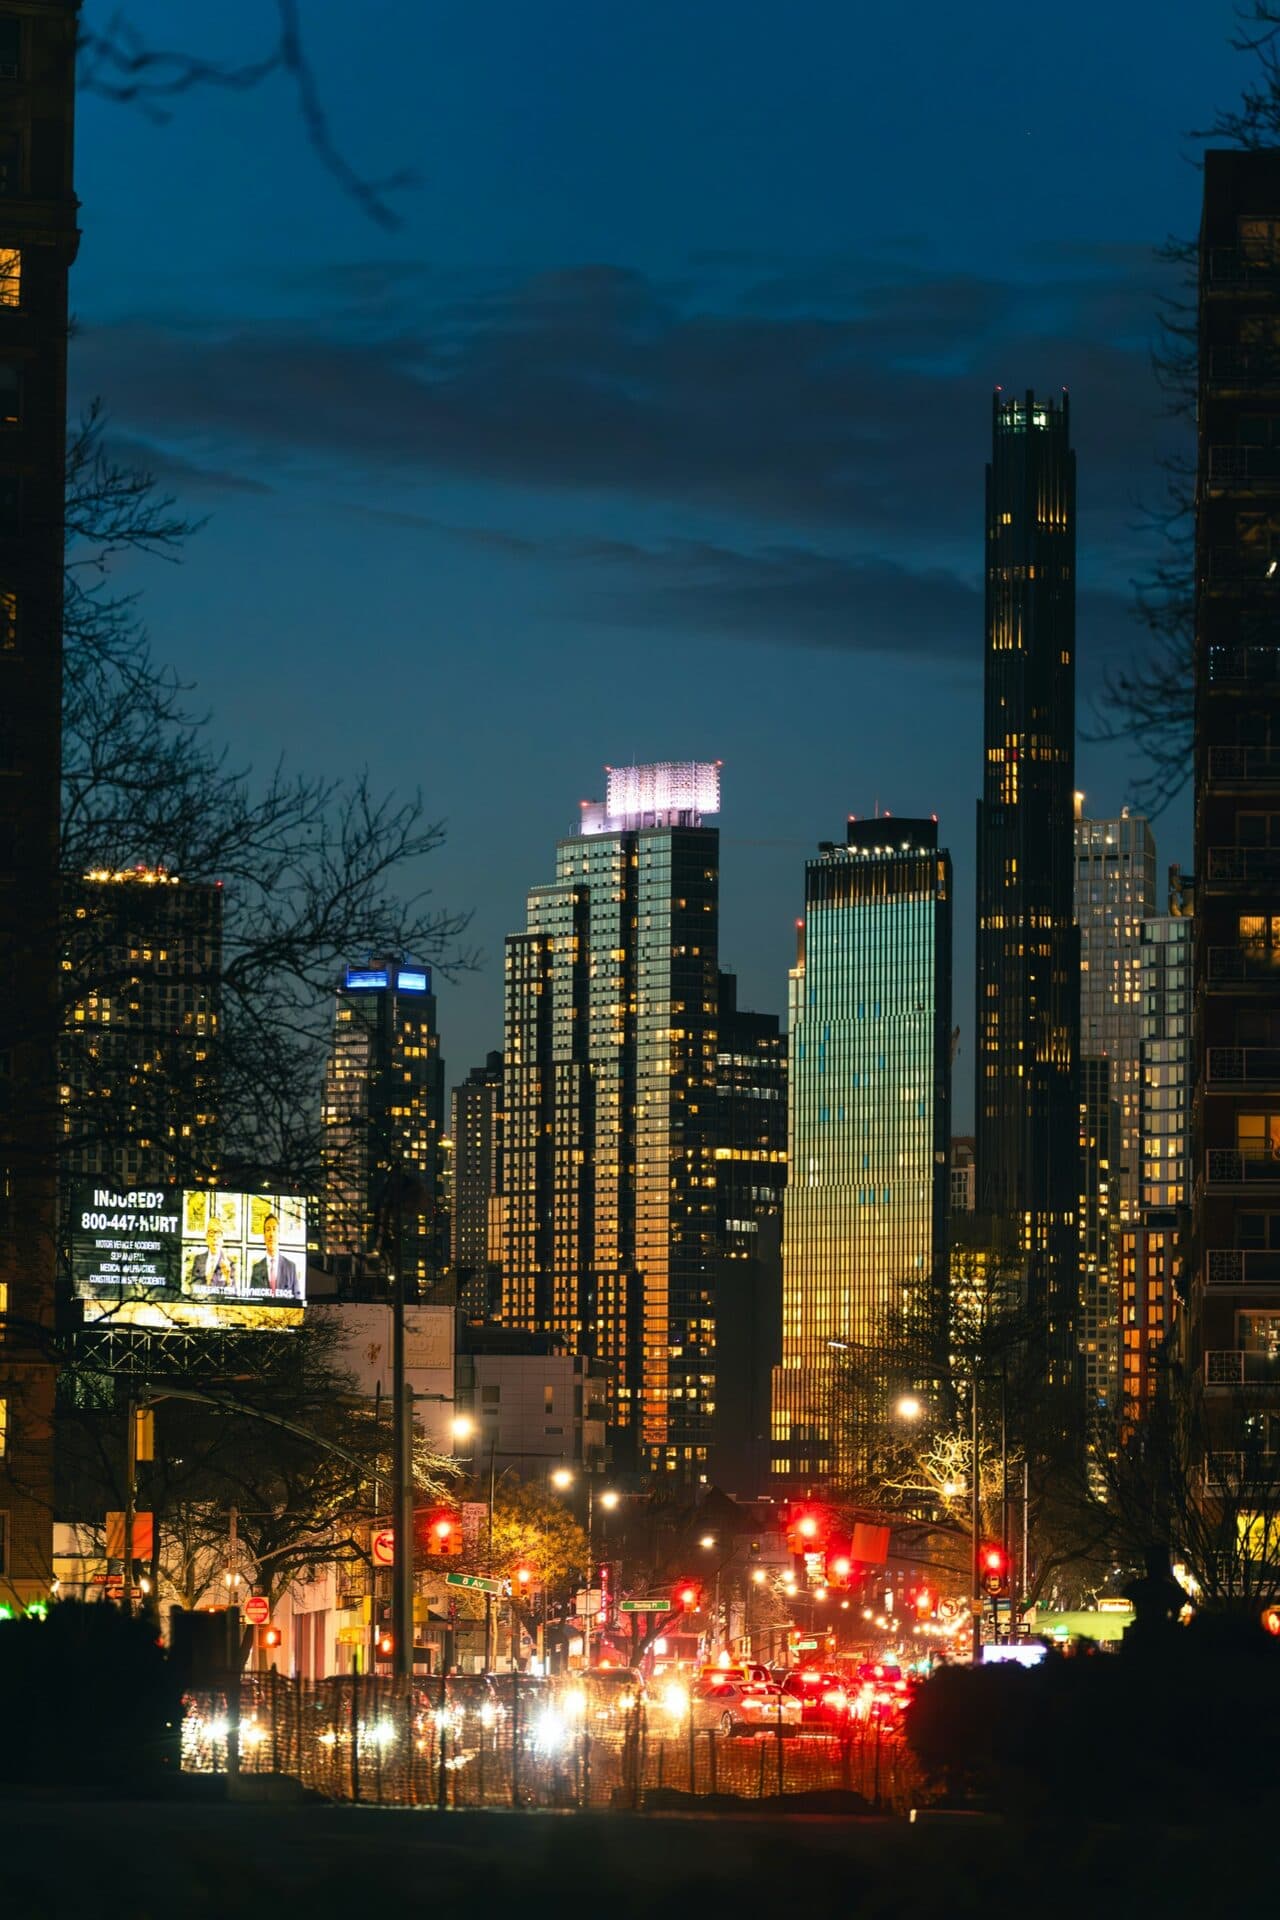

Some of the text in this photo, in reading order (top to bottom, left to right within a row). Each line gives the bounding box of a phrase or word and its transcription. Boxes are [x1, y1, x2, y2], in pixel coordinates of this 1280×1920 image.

[94, 1189, 164, 1209] INJURED?
[81, 1212, 178, 1233] 800-447-HURT
[471, 1579, 484, 1588] Av
